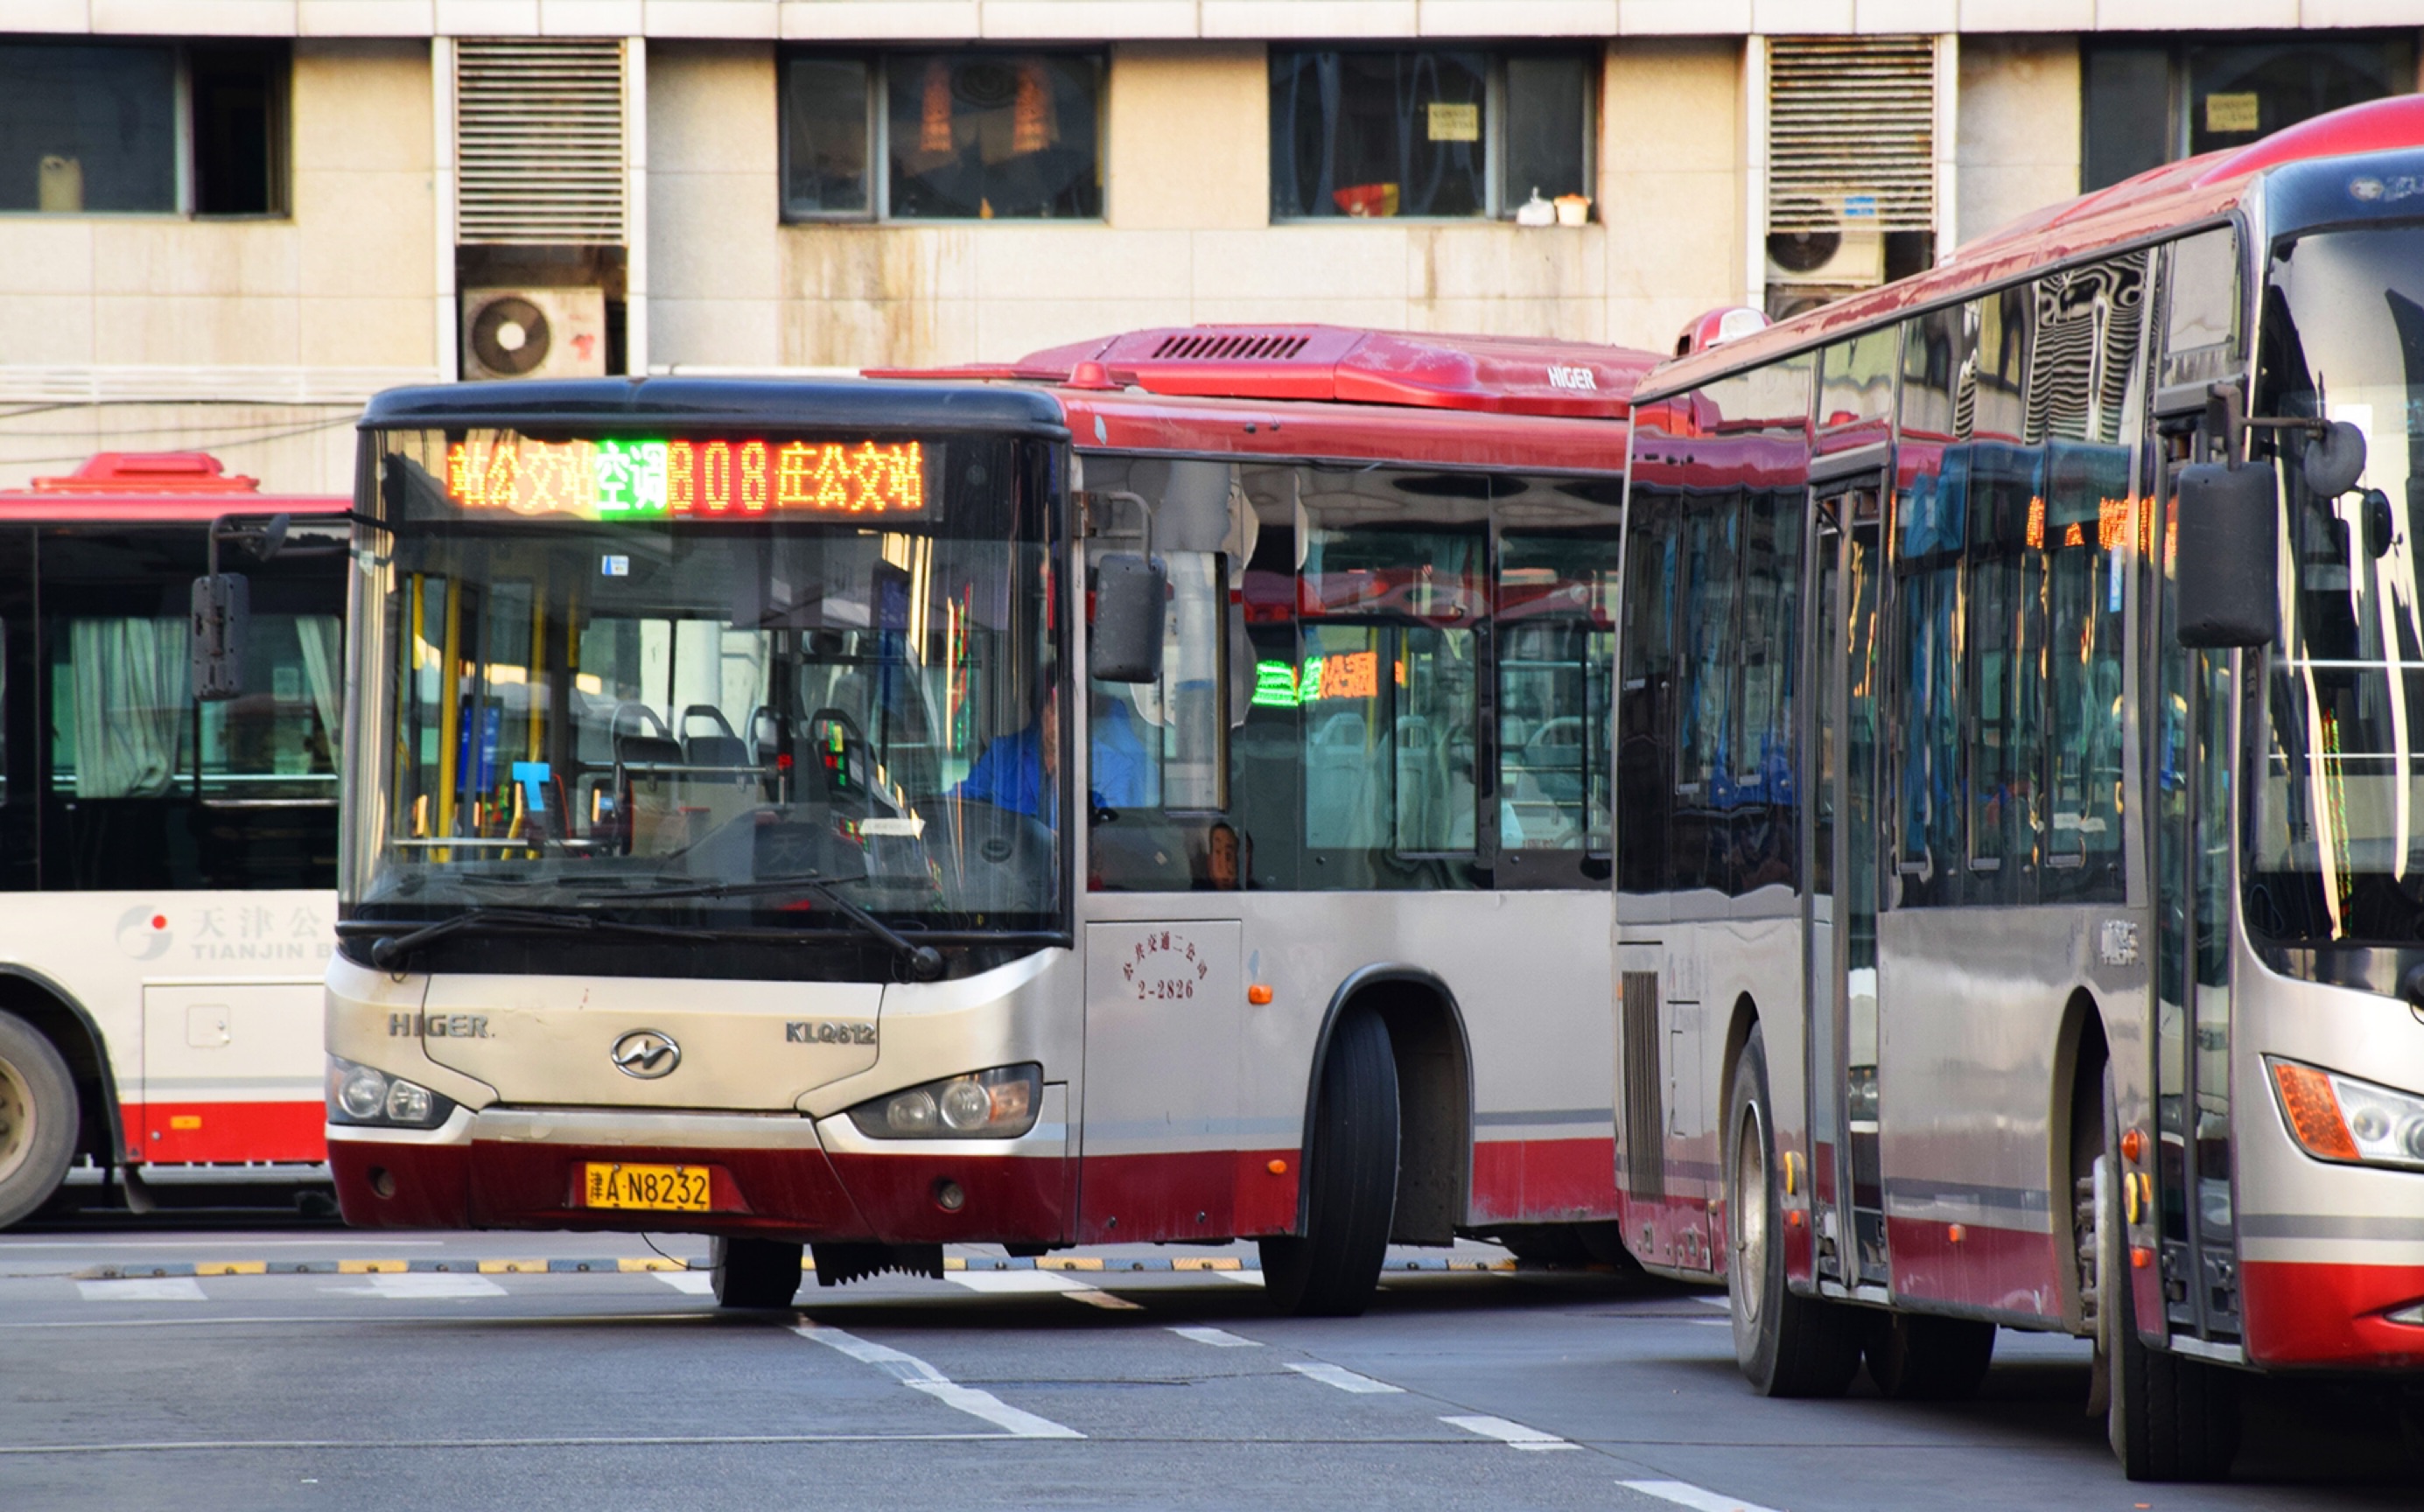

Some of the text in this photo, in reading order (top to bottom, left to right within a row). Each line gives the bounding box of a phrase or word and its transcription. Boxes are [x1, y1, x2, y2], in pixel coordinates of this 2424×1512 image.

[1547, 366, 1597, 390] HIGER
[594, 443, 669, 511] 空调
[669, 441, 767, 511] 808
[775, 441, 923, 511] 庄公交站
[191, 943, 304, 960] TIANJIN
[1138, 979, 1194, 999] 2-2826
[389, 1012, 487, 1038] HIGER
[786, 1021, 876, 1045] KLQ612
